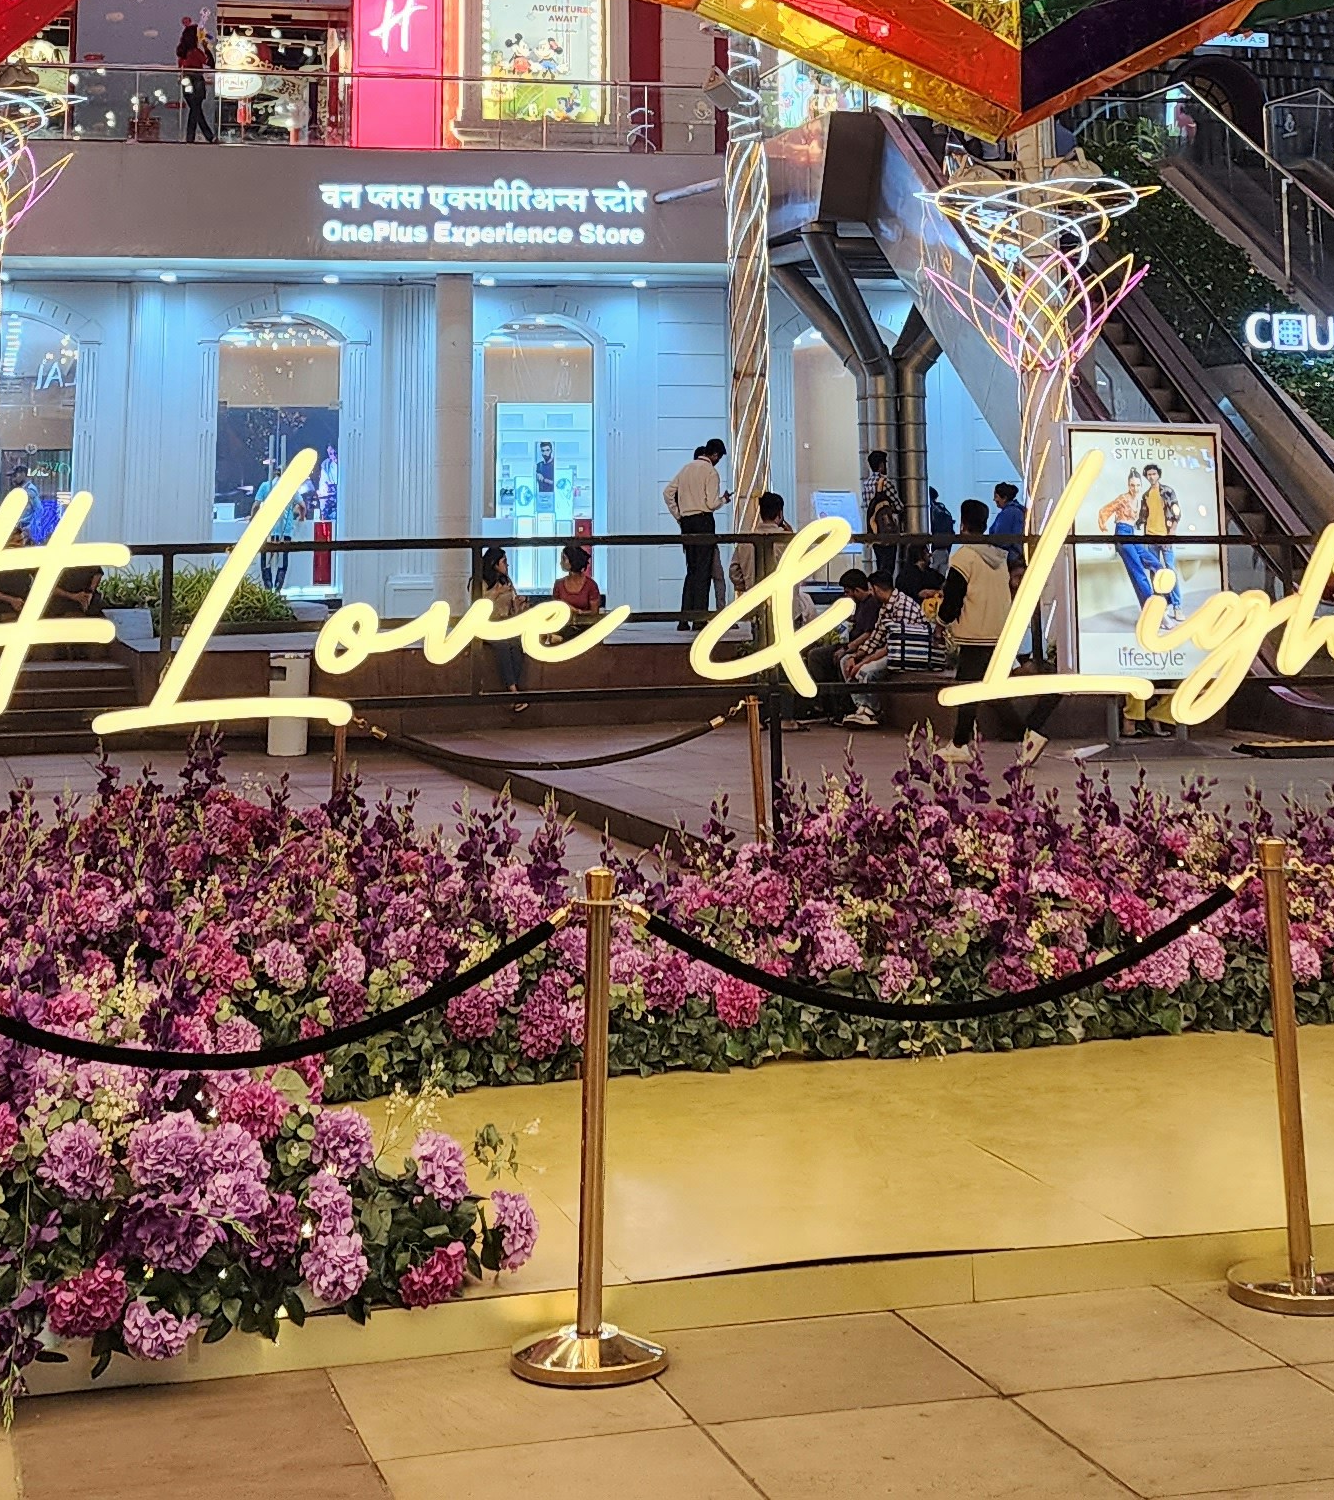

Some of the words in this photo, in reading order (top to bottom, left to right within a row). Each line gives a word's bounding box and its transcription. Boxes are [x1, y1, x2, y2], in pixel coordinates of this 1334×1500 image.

[548, 14, 578, 23] AWAIT
[319, 184, 362, 210] वन
[365, 184, 424, 210] प्लस
[592, 180, 647, 213] स्टोर
[322, 219, 428, 243] OnePlus
[433, 221, 574, 246] Experience
[578, 222, 645, 245] Store
[1114, 437, 1145, 446] SWAG
[1115, 448, 1153, 460] STYLE
[689, 515, 856, 698] &
[1118, 646, 1184, 671] lifestyle
